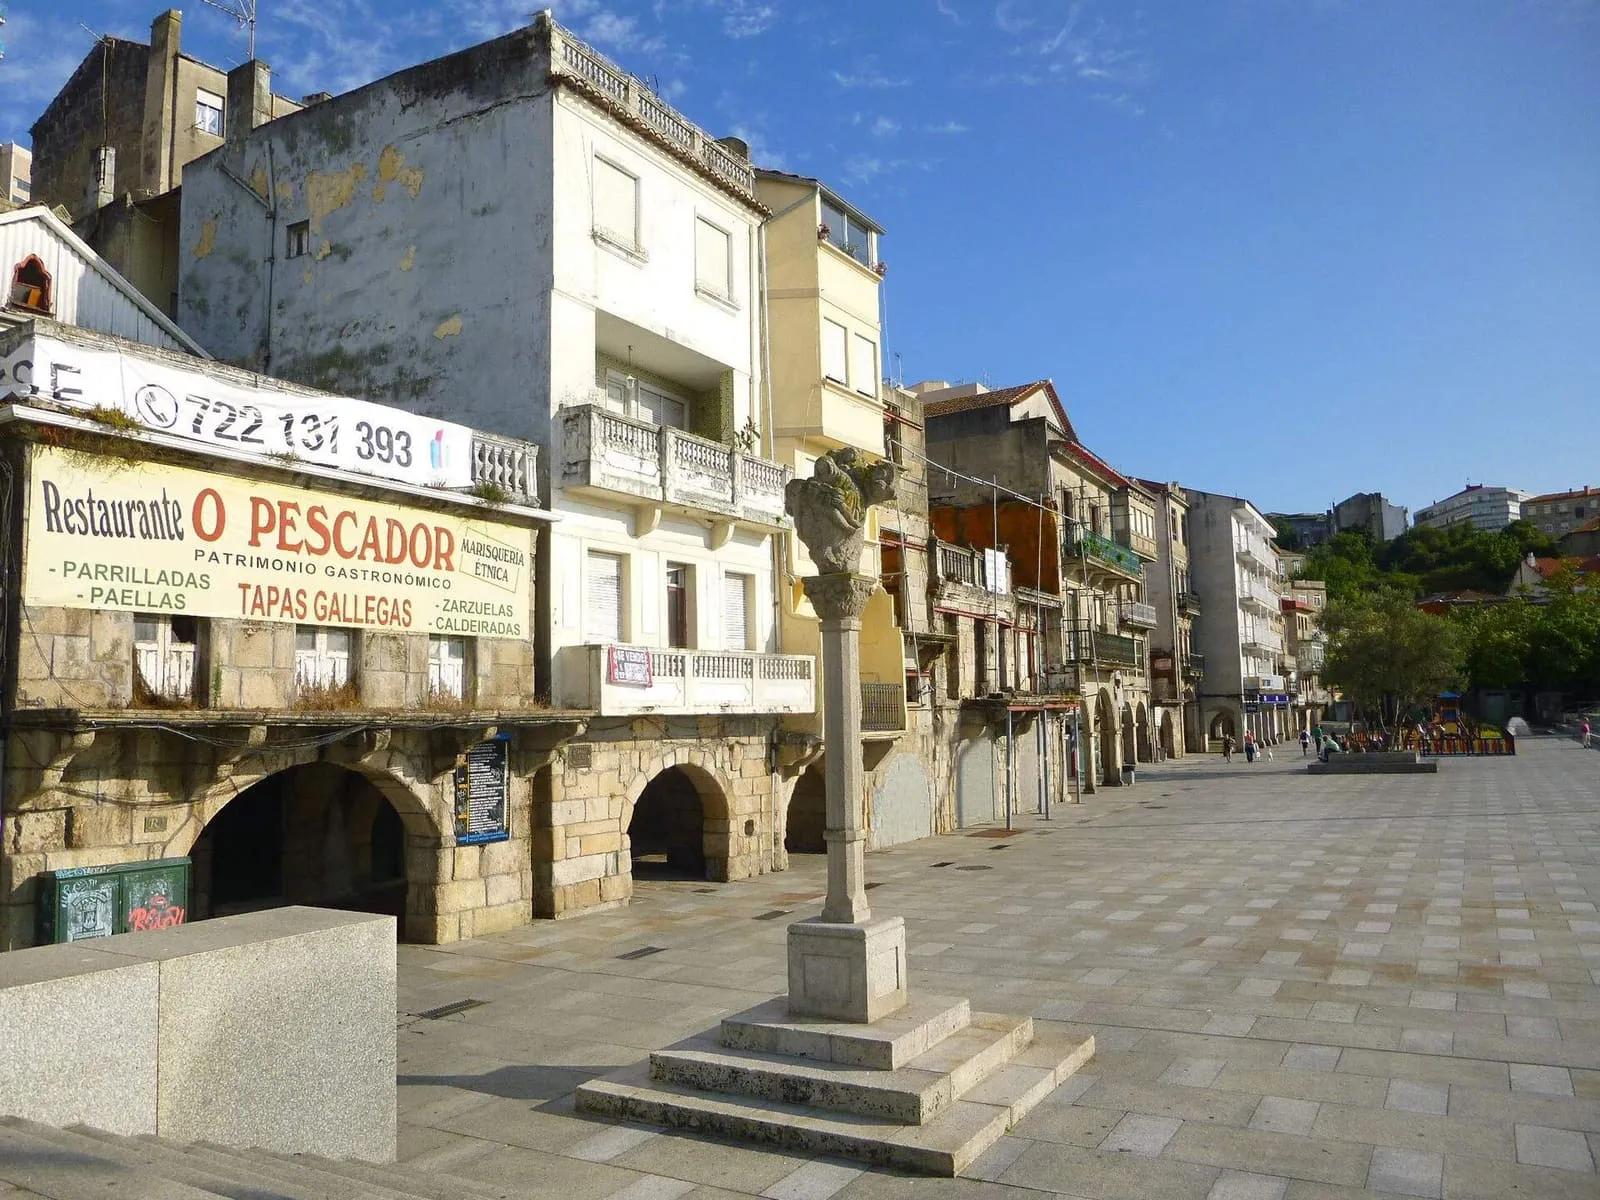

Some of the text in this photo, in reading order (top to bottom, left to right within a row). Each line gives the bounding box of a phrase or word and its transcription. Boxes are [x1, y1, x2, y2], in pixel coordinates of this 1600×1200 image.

[186, 394, 265, 446] 722
[278, 413, 340, 454] 131
[355, 421, 413, 468] 393
[42, 480, 455, 572] Restaurante O PESCADOR
[63, 560, 211, 590] PARRILLADAS
[194, 549, 452, 590] PATRIMONIO GASTRONÓMICO
[90, 586, 187, 610] PAELLAS
[238, 582, 413, 628] TAPAS GALLEGAS
[442, 598, 514, 617] ZARZUELAS
[436, 616, 521, 636] CALDEIRADAS
